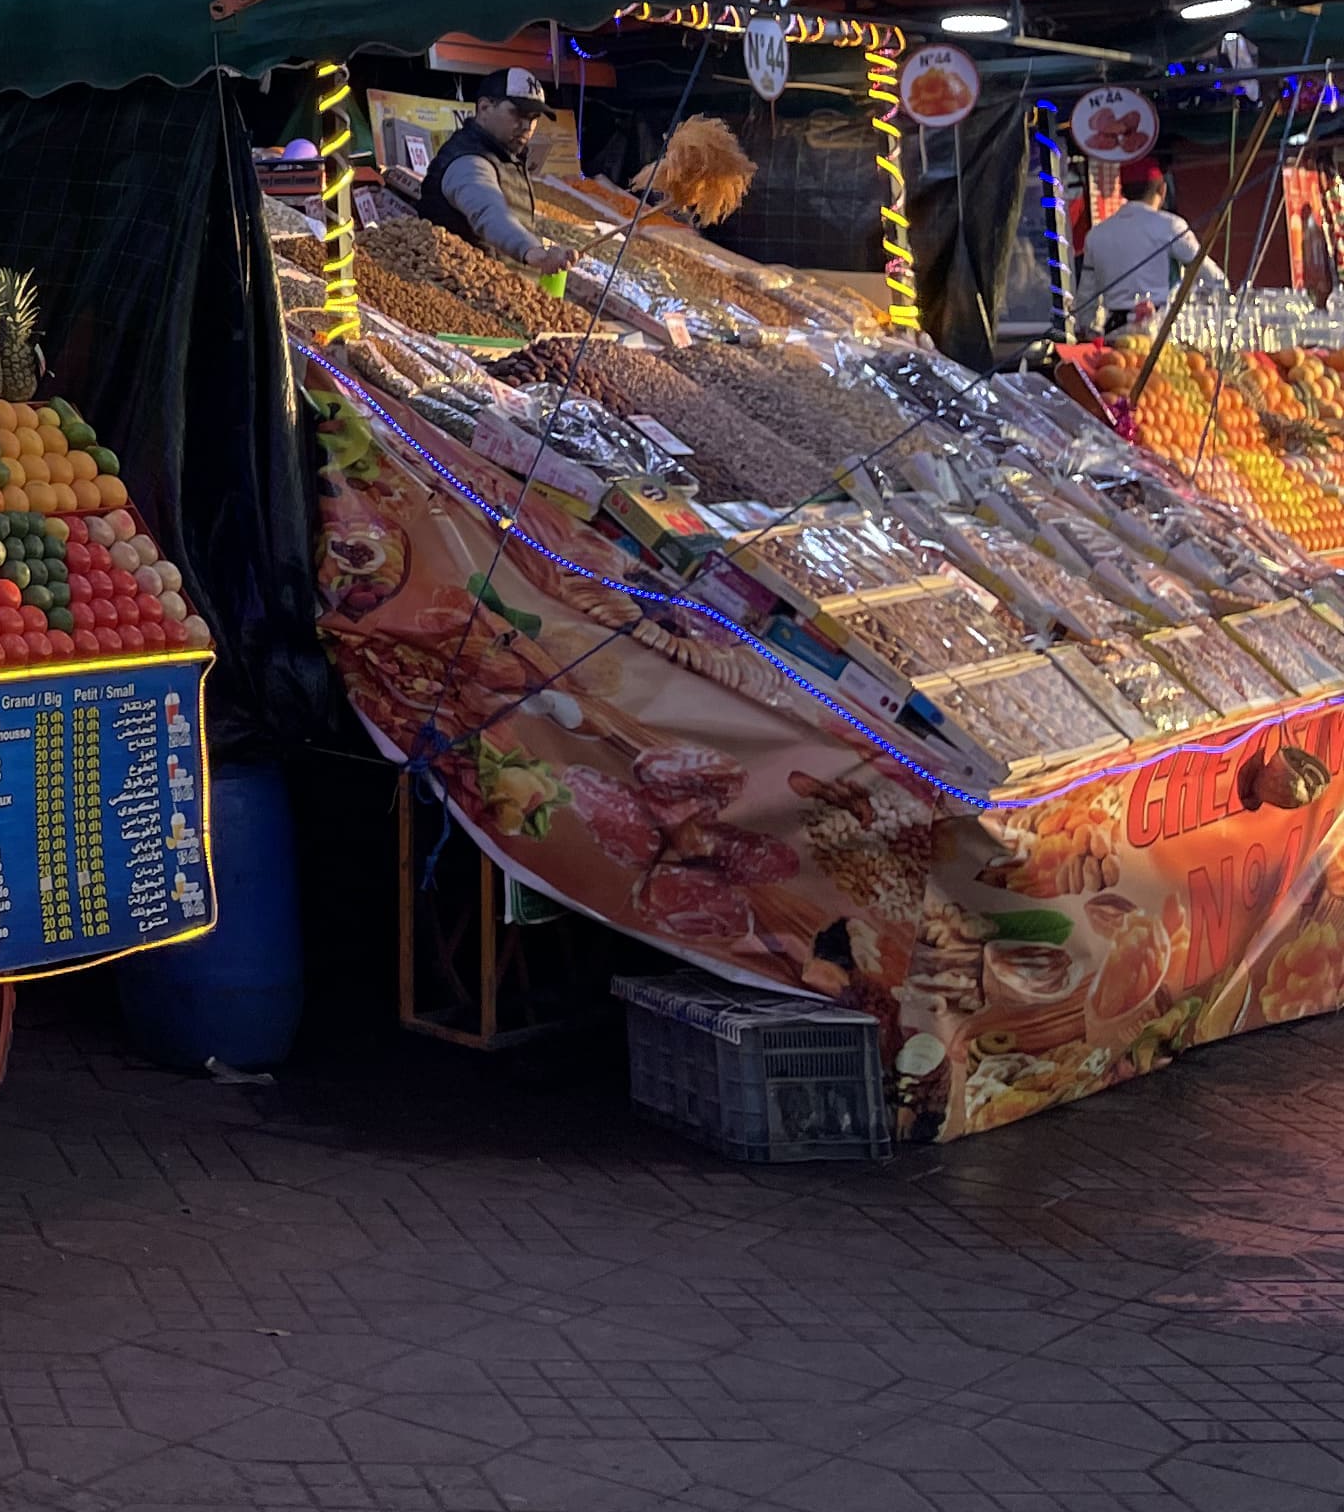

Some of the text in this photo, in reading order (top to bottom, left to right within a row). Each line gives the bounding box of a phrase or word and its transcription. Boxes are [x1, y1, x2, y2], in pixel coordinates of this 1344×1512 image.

[1, 692, 62, 710] Grand Big
[74, 683, 135, 702] Petit Small
